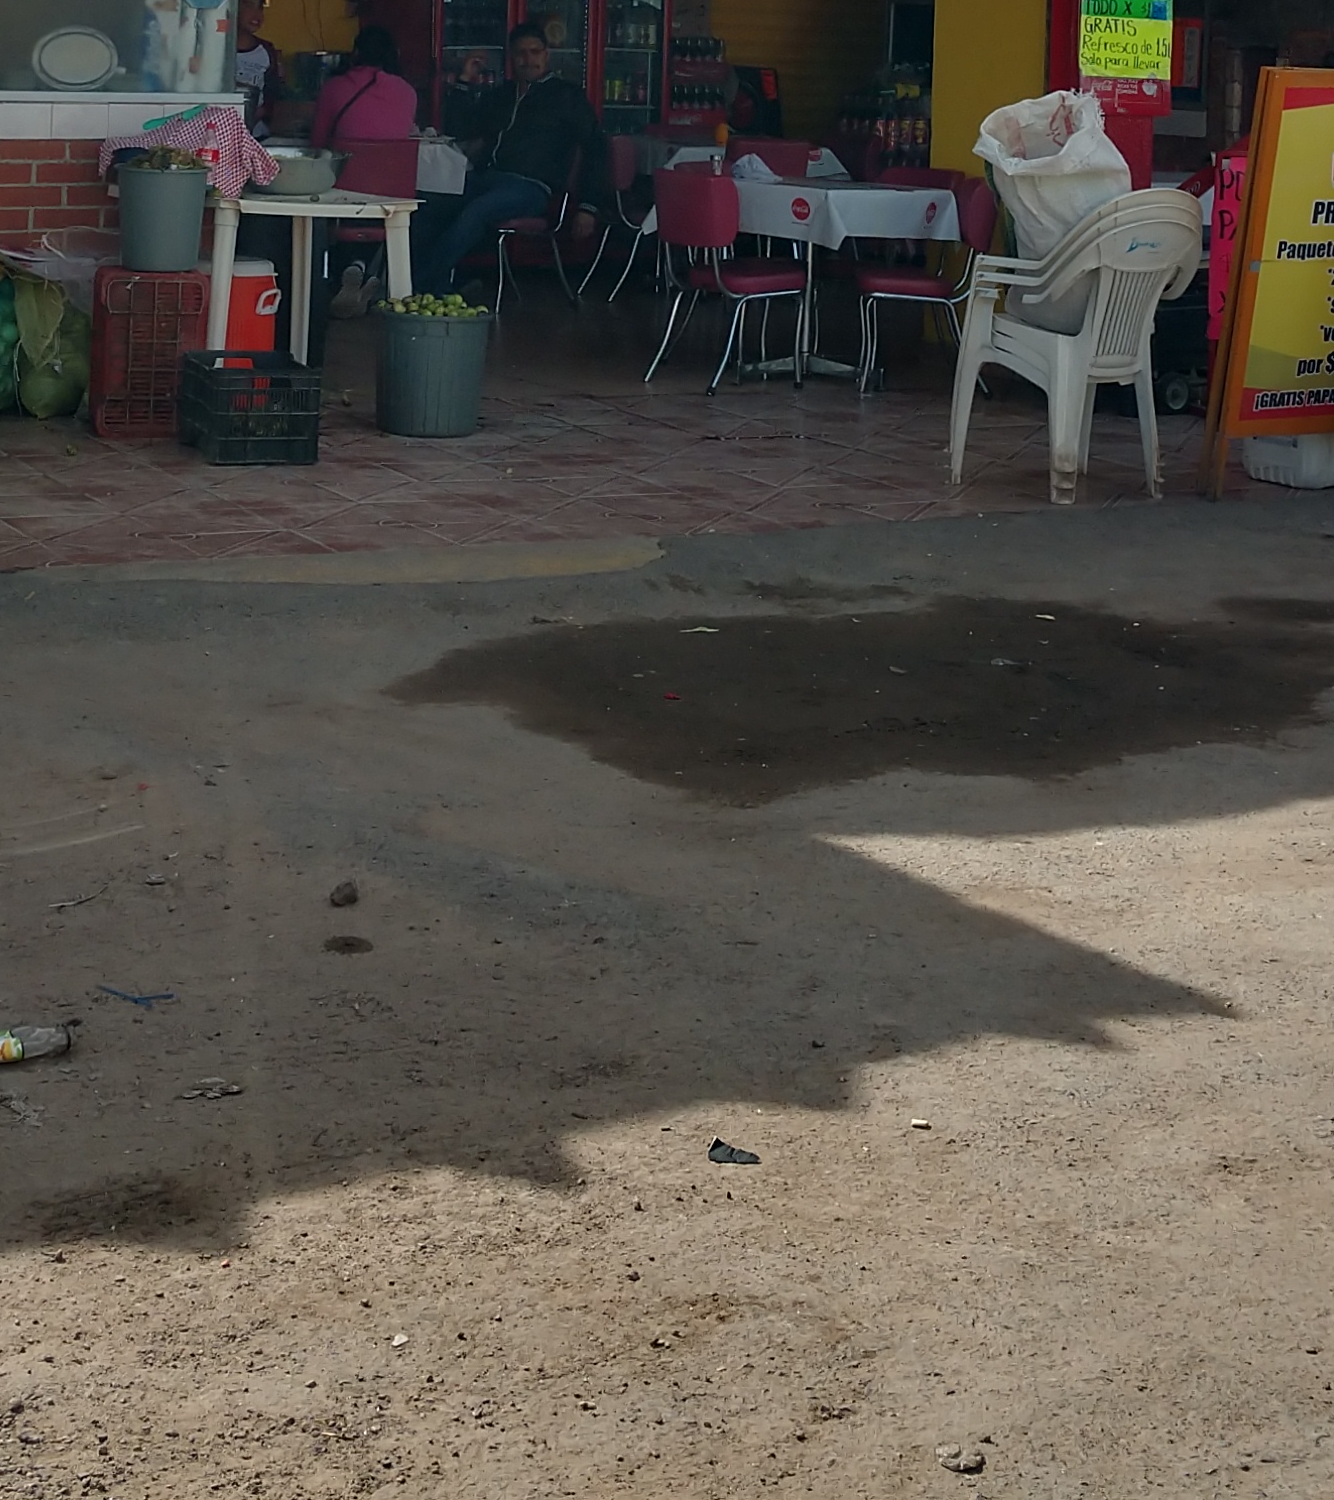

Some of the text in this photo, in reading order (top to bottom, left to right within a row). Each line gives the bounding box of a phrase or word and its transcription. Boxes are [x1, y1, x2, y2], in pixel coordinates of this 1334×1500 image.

[1083, 17, 1137, 37] GRATIS
[1082, 34, 1139, 55] Refresco
[1140, 39, 1153, 56] de
[1104, 56, 1129, 70] para
[1133, 55, 1162, 71] llevar
[1296, 359, 1324, 377] por
[1254, 389, 1306, 411] ¡GRATIS
